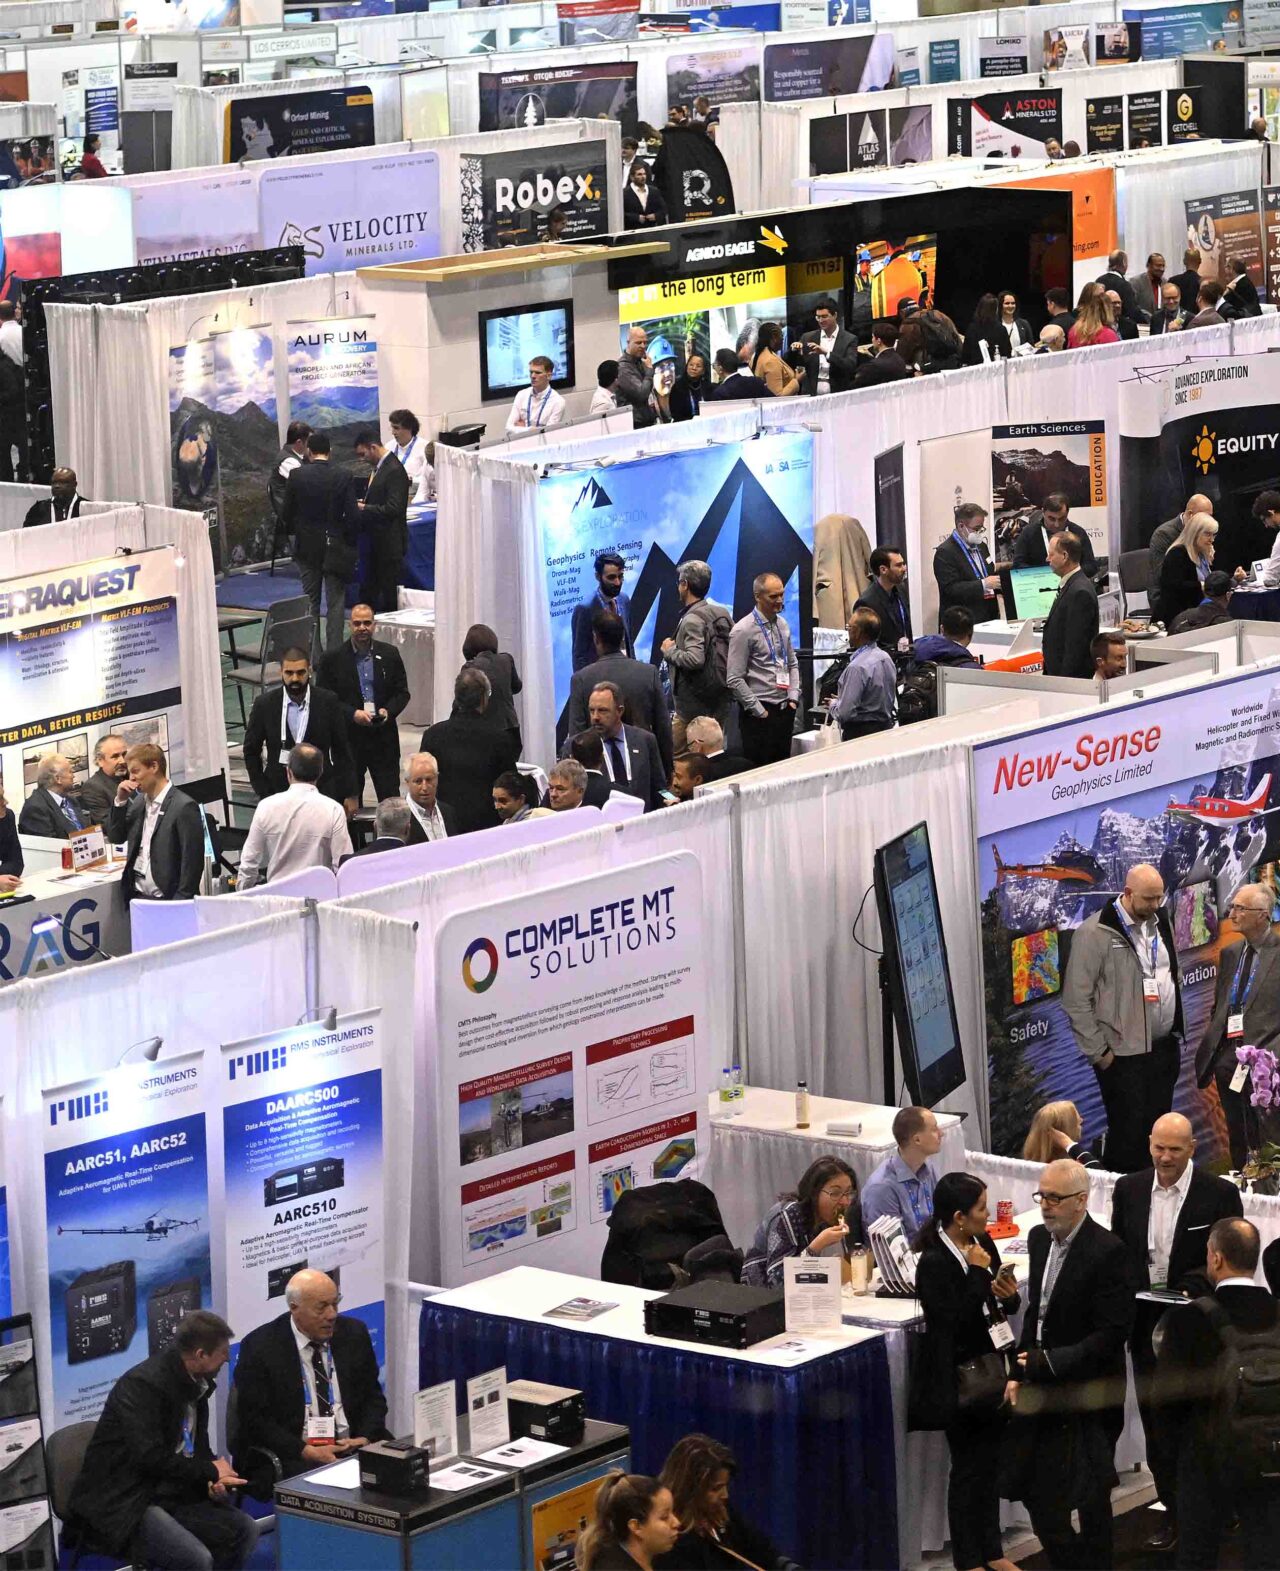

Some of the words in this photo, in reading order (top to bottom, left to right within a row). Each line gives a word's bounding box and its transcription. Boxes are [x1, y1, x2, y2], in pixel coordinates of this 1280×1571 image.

[254, 43, 271, 53] LOS
[273, 39, 300, 52] CERROS
[301, 37, 331, 48] LIMITED
[774, 69, 802, 80] Responsibly
[802, 68, 823, 76] sourced
[1016, 99, 1056, 110] ASTON
[1016, 110, 1043, 119] MINERALS
[1044, 109, 1057, 117] LTD
[311, 111, 329, 120] Mining
[1173, 123, 1198, 132] GETCHELL
[858, 144, 879, 155] ATLAS
[328, 212, 428, 242] VELOCITY
[346, 242, 394, 257] MINERALS
[398, 241, 418, 251] LTD.
[686, 246, 724, 262] AGNICO
[725, 241, 755, 256] EAGLE
[661, 280, 686, 298] the
[692, 274, 725, 295] long
[731, 268, 766, 287] term
[295, 330, 367, 347] AURUM
[295, 365, 329, 374] EUROPEAN
[330, 364, 342, 372] AND
[345, 362, 370, 370] AFRICAN
[302, 373, 327, 381] PROJECT
[329, 369, 366, 379] GENERATOR
[1175, 372, 1199, 391] ADVANCED
[1201, 366, 1248, 385] EXPLORATION
[1175, 391, 1187, 404] SINCE
[1189, 387, 1202, 401] 1987
[1009, 424, 1037, 435] Earth
[1040, 422, 1086, 433] Sciences
[1217, 434, 1279, 455] EQUITY
[546, 551, 586, 568] Geophysics
[590, 544, 615, 557] Remote
[617, 539, 643, 554] Sensing
[551, 566, 581, 578] Drone-Mag
[557, 577, 577, 587] VLF-EM
[550, 596, 584, 608] Radiometrics
[553, 587, 580, 596] Walk-Mag
[62, 620, 82, 633] VLF-EM
[1231, 702, 1263, 717] Worldwide
[22, 725, 46, 739] DATA,
[51, 717, 81, 730] BETTER
[1207, 722, 1239, 736] Helicopter
[1240, 717, 1253, 727] and
[1254, 712, 1271, 724] Fixed
[1195, 736, 1223, 751] Magnetic
[1225, 732, 1237, 742] and
[1238, 724, 1273, 739] Radiometric
[993, 725, 1161, 794] New-Sense
[1051, 774, 1112, 801] Geophysics
[1114, 761, 1153, 786] Limited
[506, 898, 635, 958] COMPLETE
[643, 886, 674, 920] MT
[530, 917, 676, 979] SOLUTIONS
[312, 1026, 374, 1048] INSTRUMENTS
[1009, 1018, 1049, 1044] Safety
[266, 1086, 339, 1115] DAARC500
[65, 1148, 126, 1175] AARC51,
[131, 1132, 187, 1158] AARC52
[58, 1181, 83, 1197] Adaptive
[85, 1172, 123, 1190] Aeromagnetic
[125, 1167, 153, 1180] Real-Time
[154, 1156, 194, 1174] Compensation
[479, 1178, 500, 1192] DETAILED
[501, 1169, 537, 1186] INTERPRETATION
[538, 1162, 558, 1175] REPORTS
[274, 1198, 337, 1225] AARC510
[281, 1494, 300, 1508] DATA
[304, 1500, 354, 1520] ACQUISITION
[358, 1512, 396, 1529] SYSTEMS
